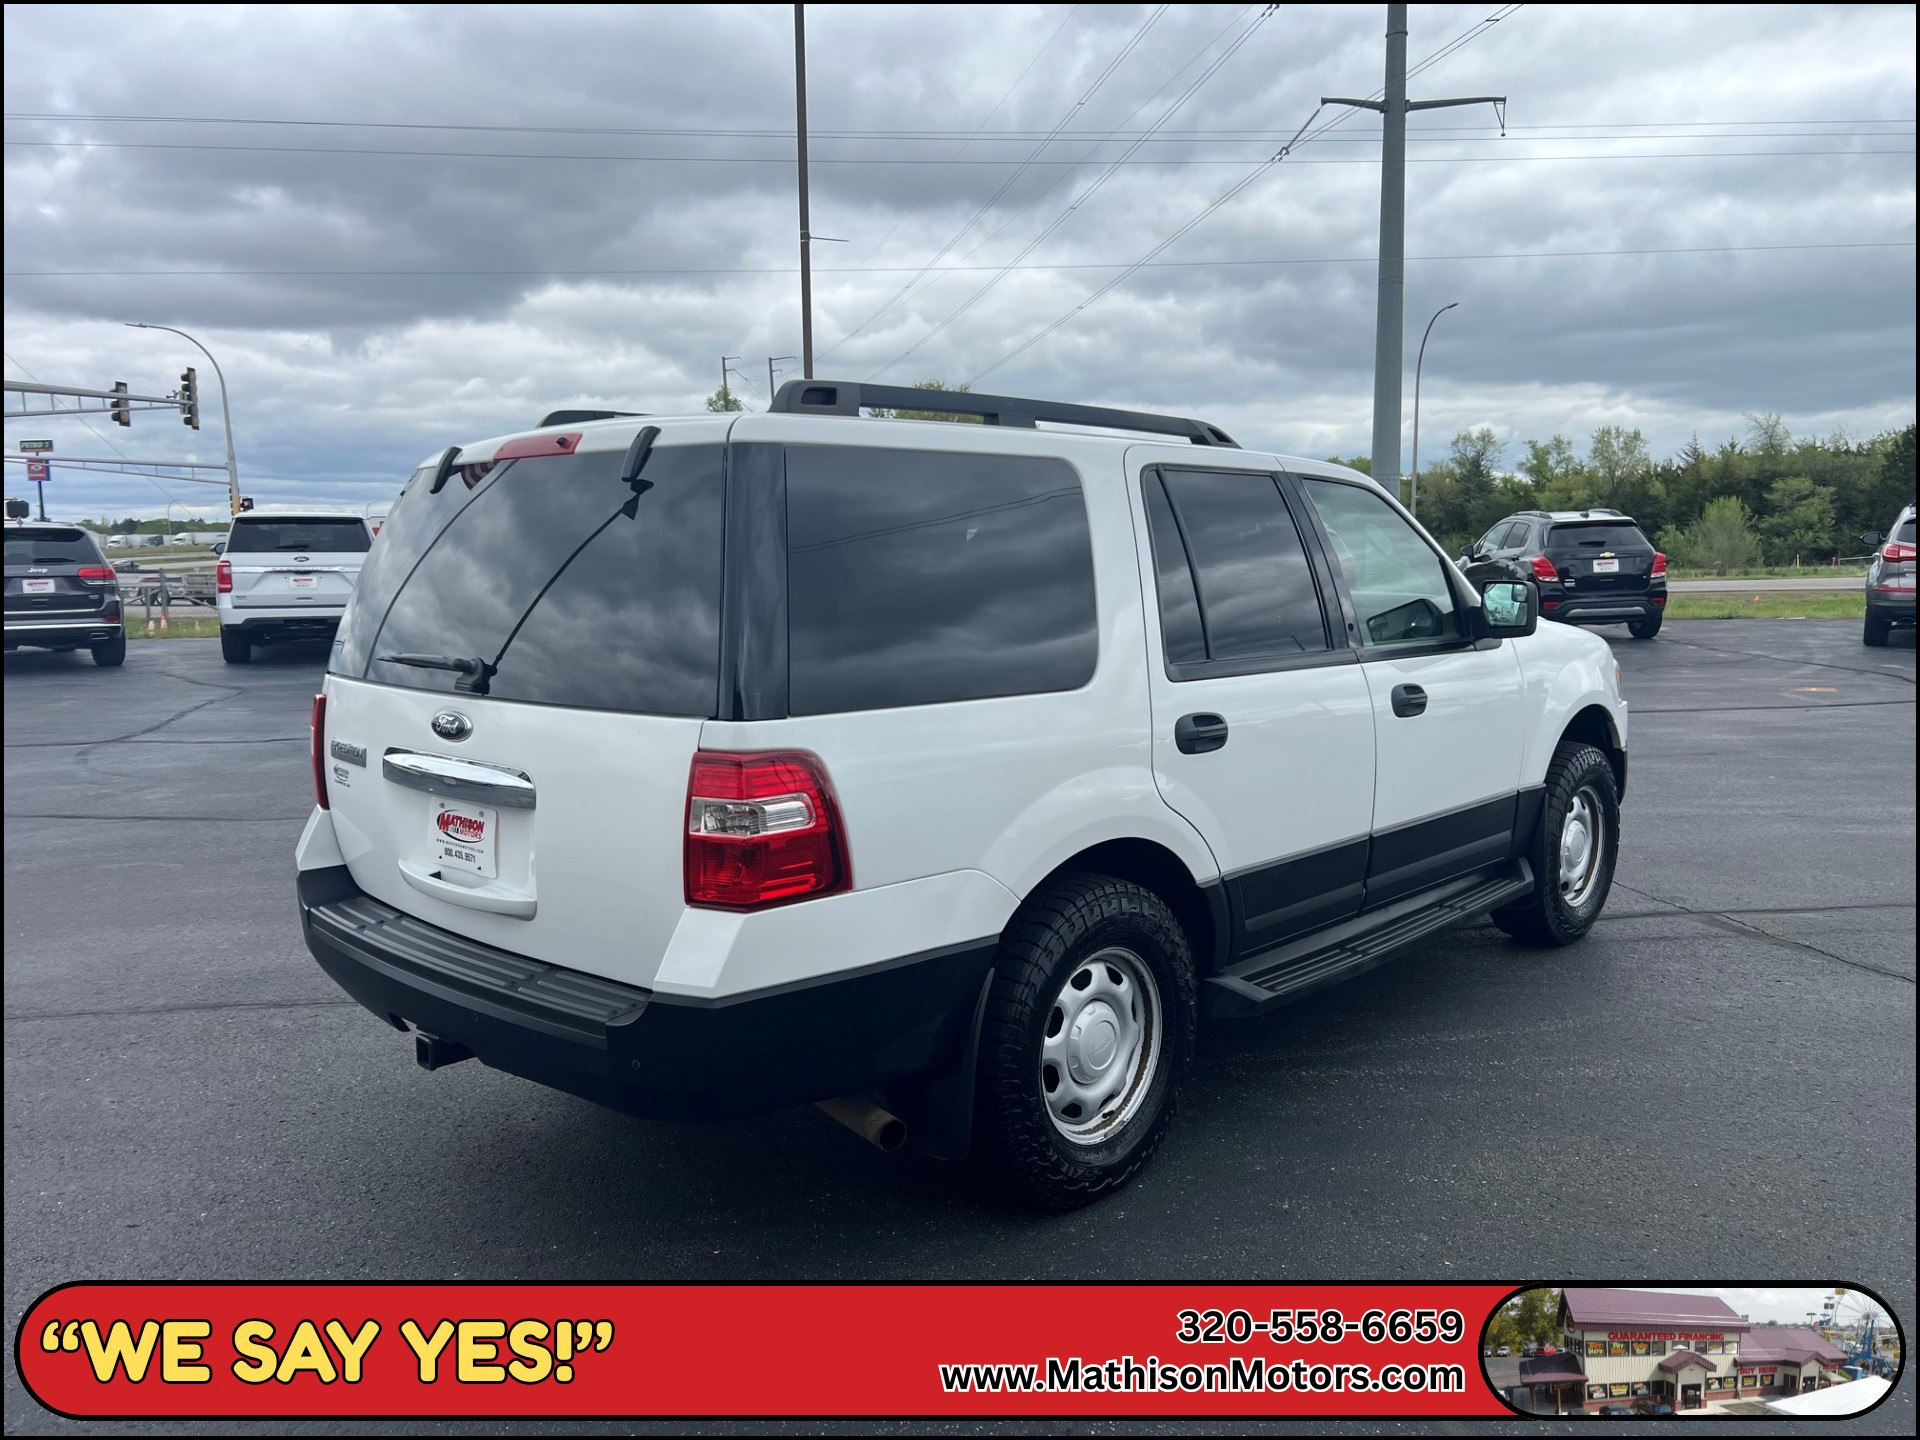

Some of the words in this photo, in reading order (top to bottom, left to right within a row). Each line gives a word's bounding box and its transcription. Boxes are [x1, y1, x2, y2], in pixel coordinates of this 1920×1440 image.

[435, 714, 460, 734] Ford
[439, 812, 485, 834] MATHISON
[459, 828, 483, 840] MOTORS
